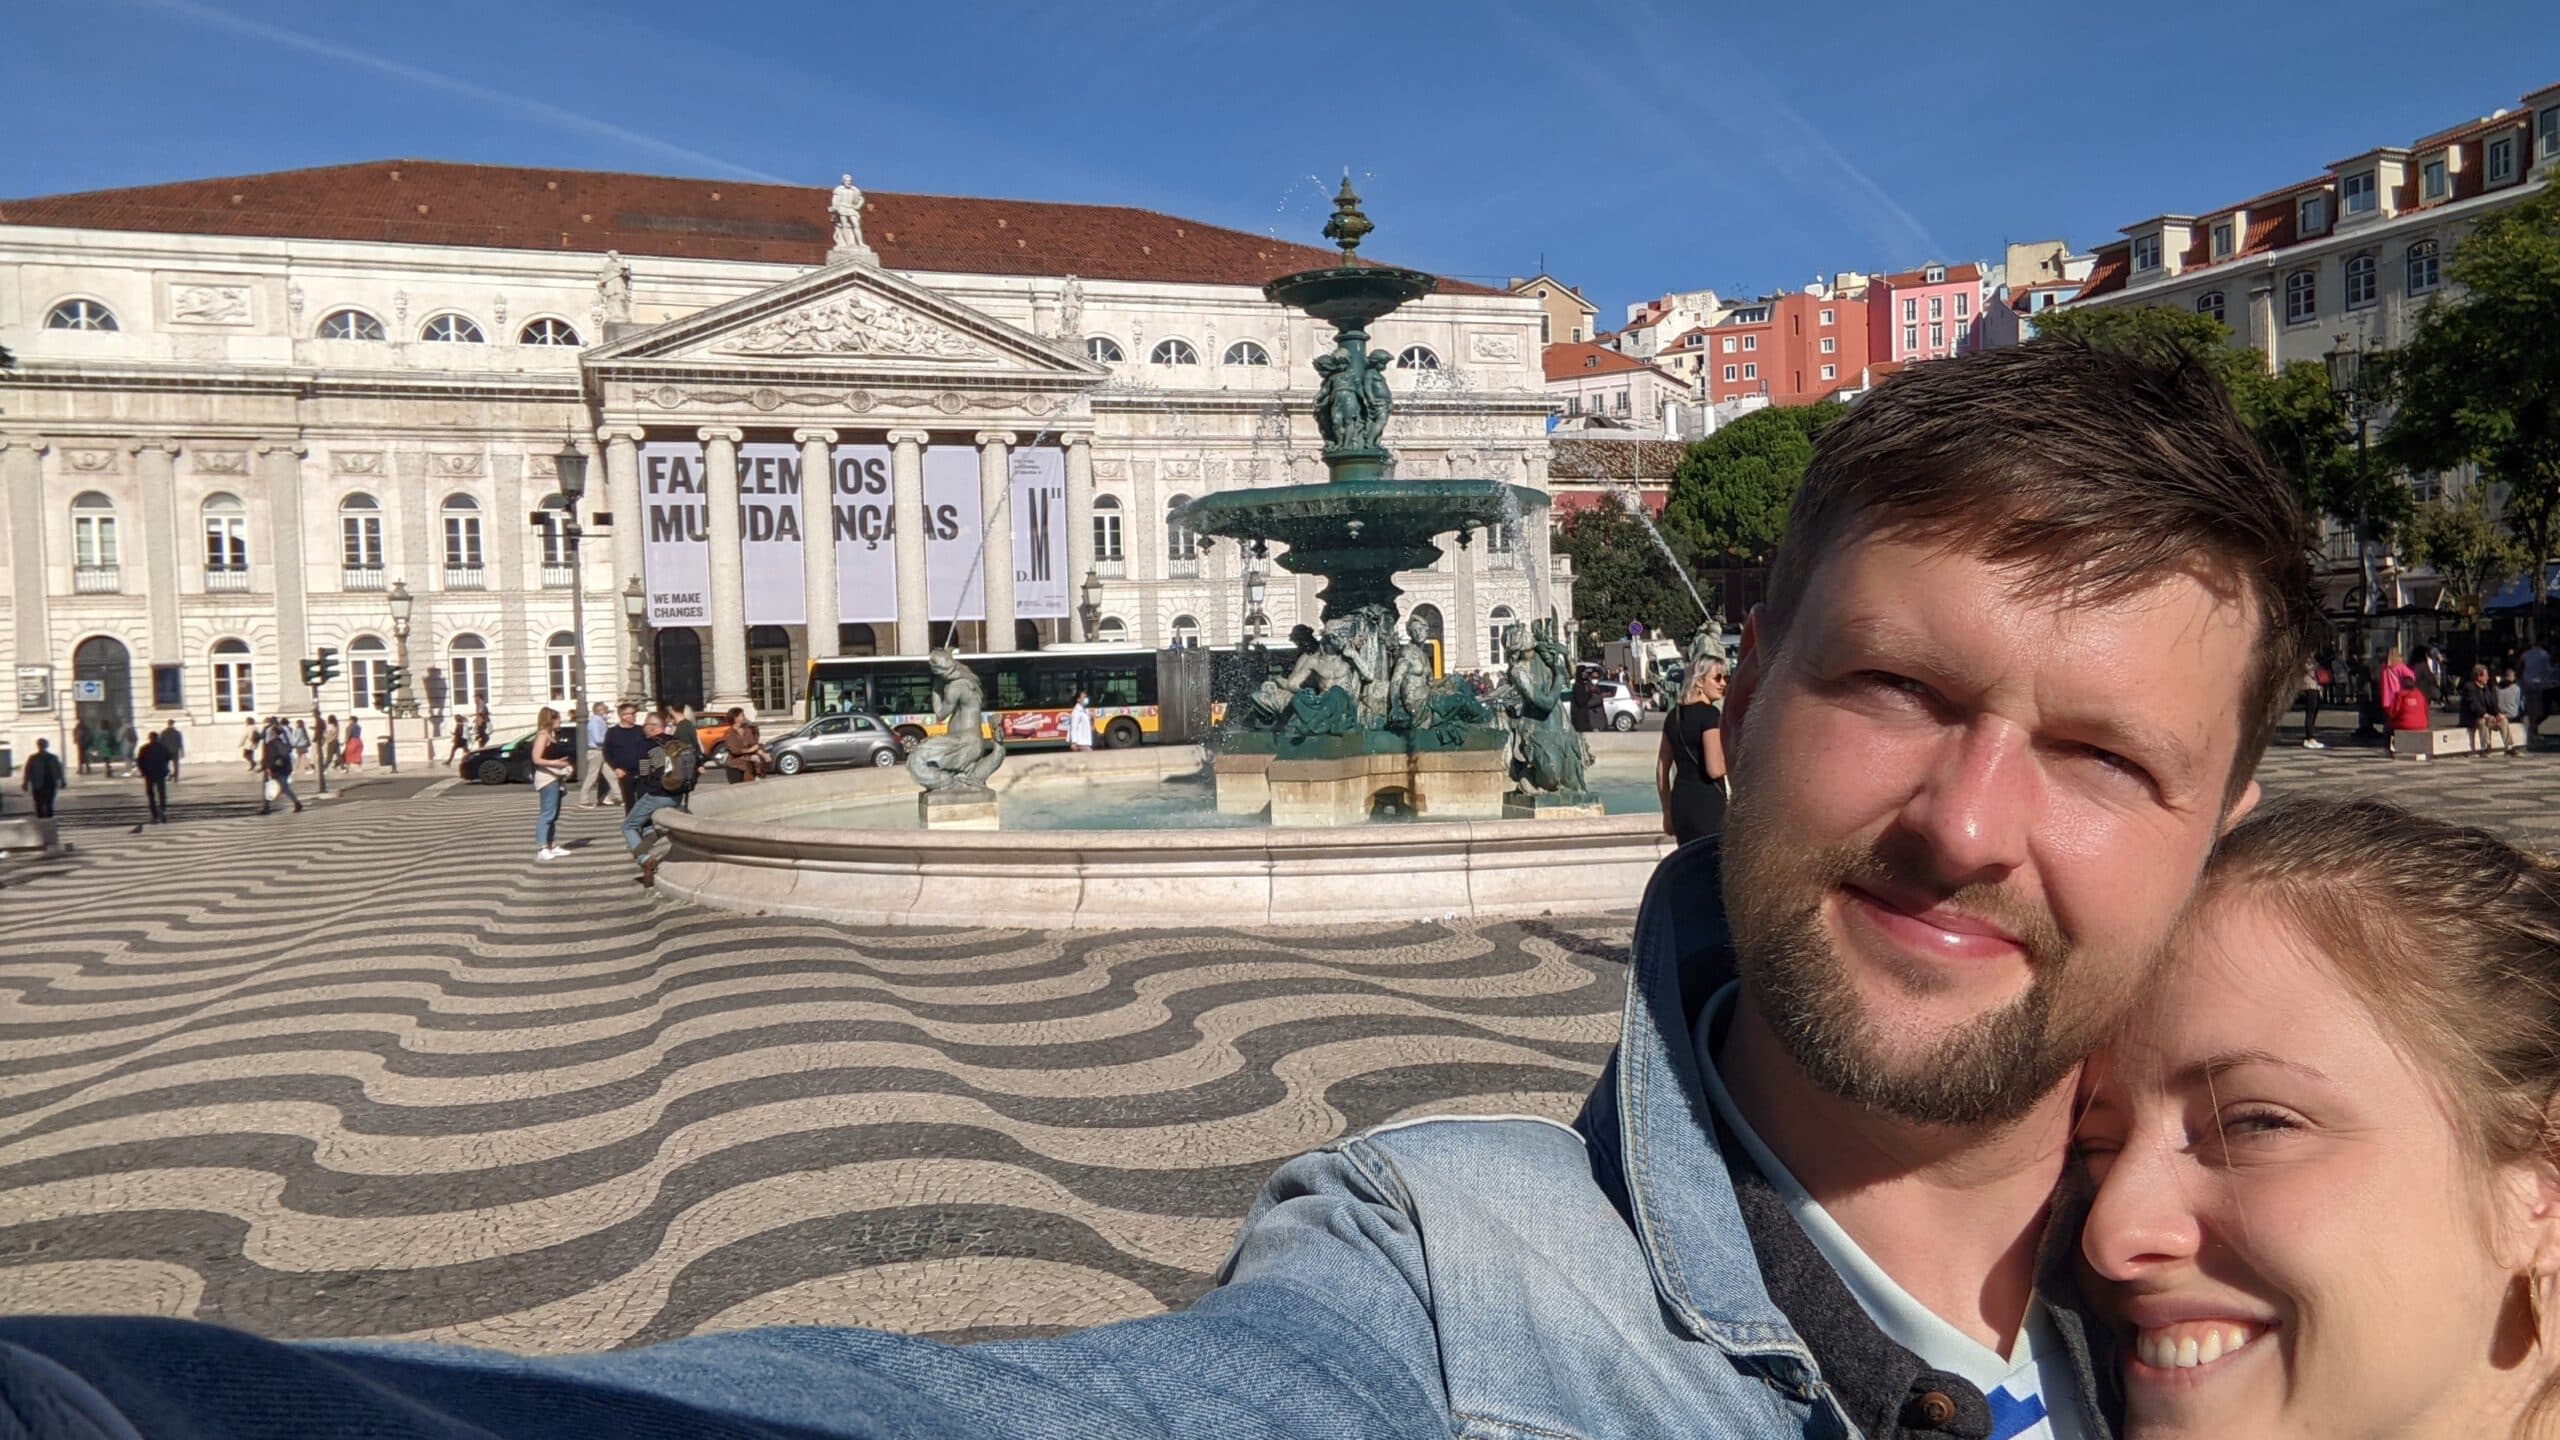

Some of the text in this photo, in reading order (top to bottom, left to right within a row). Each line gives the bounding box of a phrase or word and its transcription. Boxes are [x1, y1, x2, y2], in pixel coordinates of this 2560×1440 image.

[653, 592, 702, 605] WE MAKE
[653, 606, 704, 619] CHANGES
